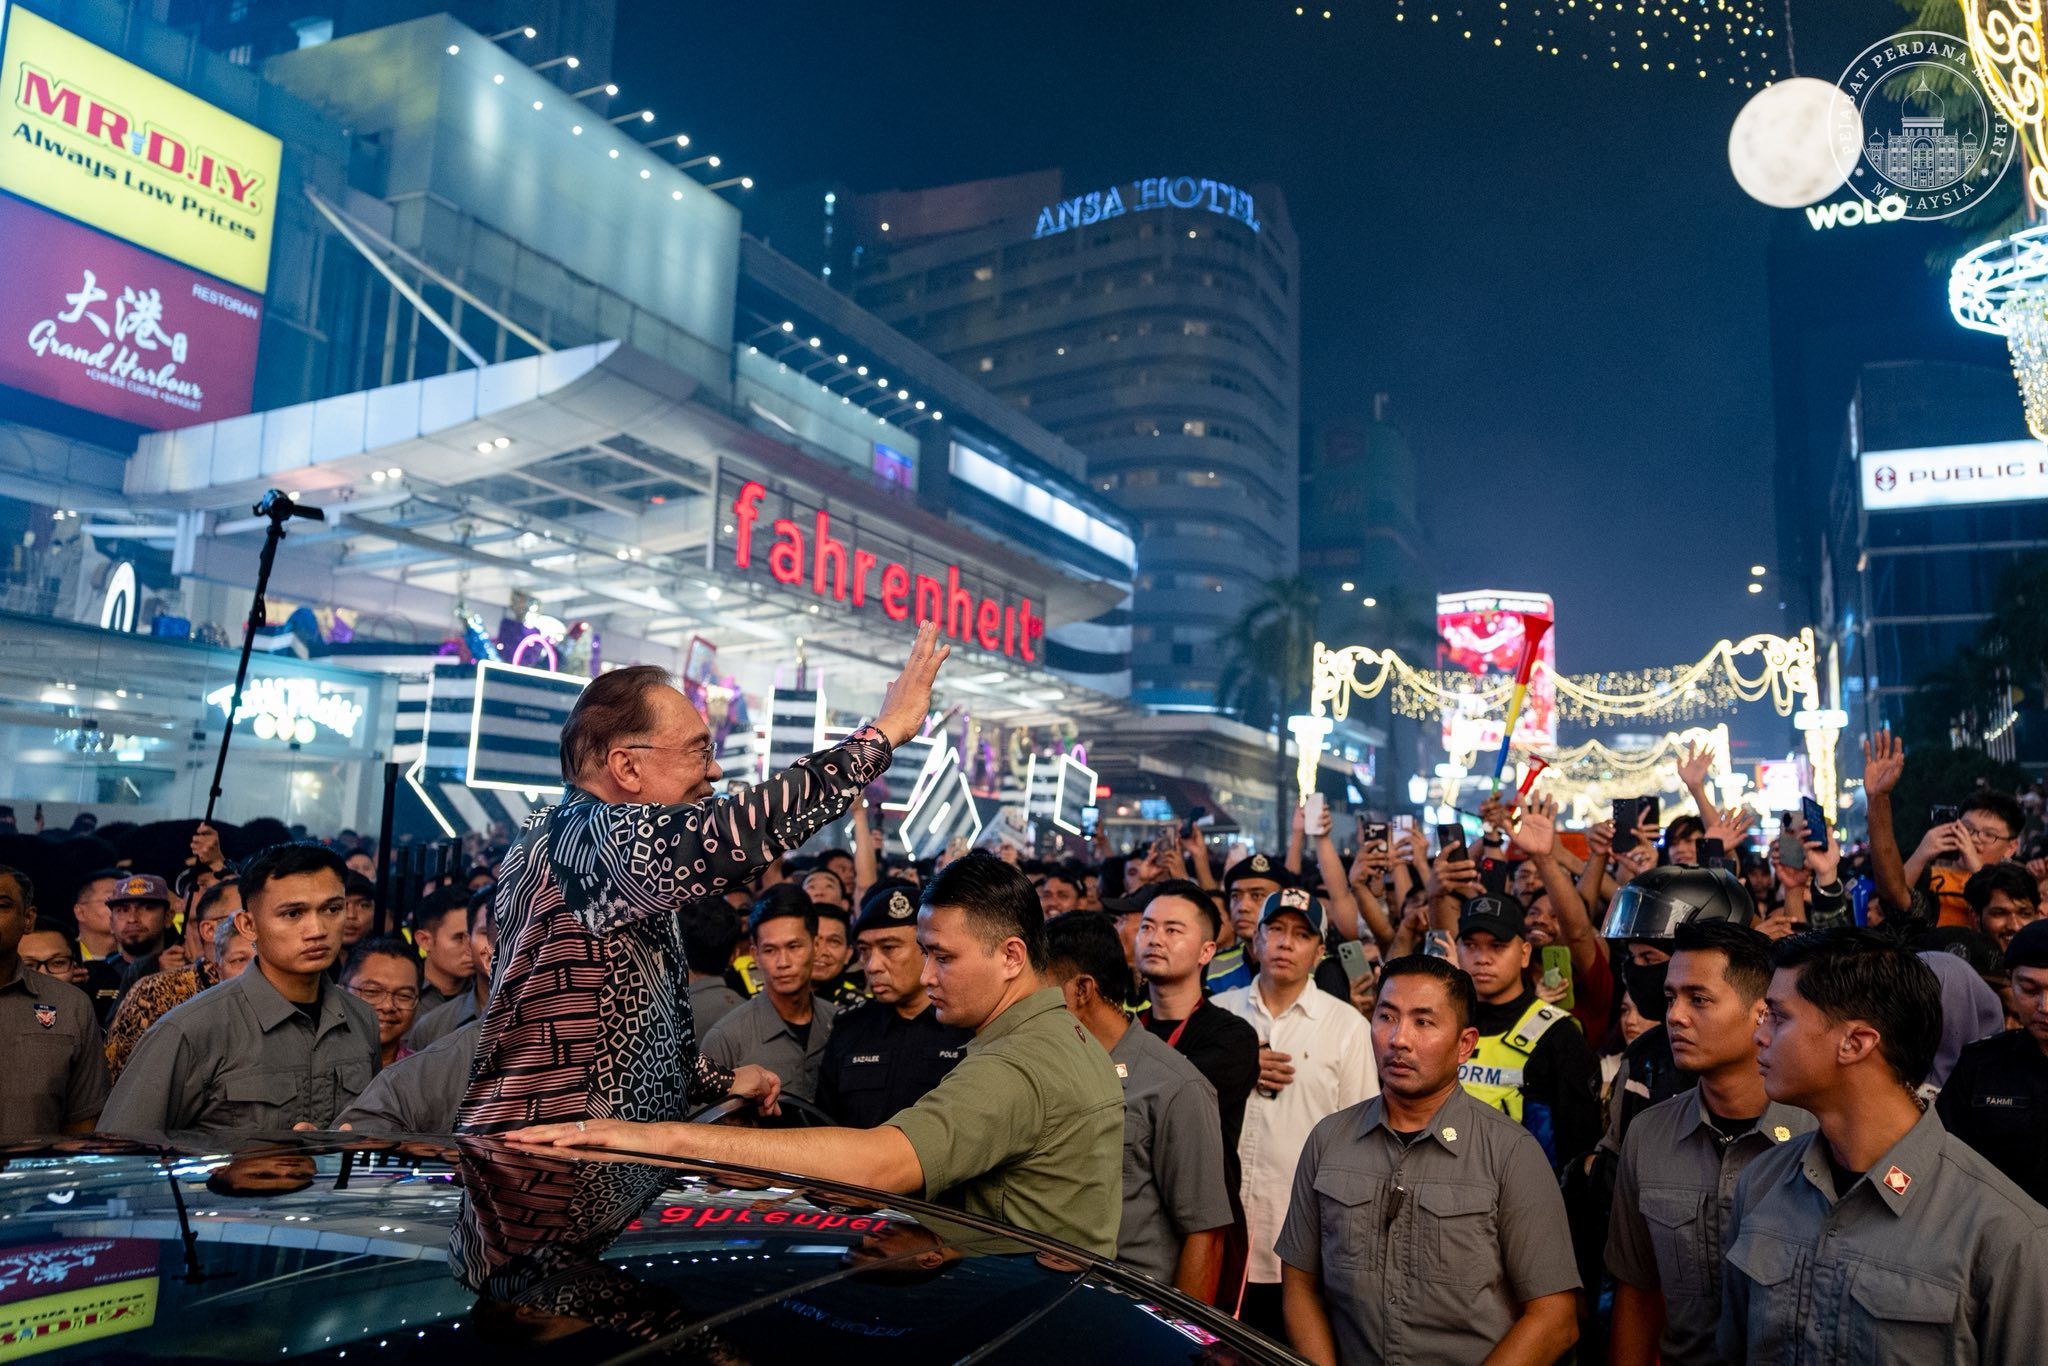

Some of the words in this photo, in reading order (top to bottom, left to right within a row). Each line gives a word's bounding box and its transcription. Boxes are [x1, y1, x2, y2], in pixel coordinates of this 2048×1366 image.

[23, 70, 129, 150] MR
[147, 130, 257, 209] D.I.Y.
[13, 122, 117, 180] Always
[124, 170, 177, 205] Low
[182, 196, 257, 241] Prices
[1031, 185, 1127, 240] ANSA
[1805, 195, 1906, 231] WOLO
[192, 283, 259, 320] RESTORAN
[28, 319, 115, 369] Grand
[109, 345, 203, 400] Harbour
[1909, 462, 2026, 484] PUBLIC
[733, 481, 1036, 663] fahrenheit
[1985, 1096, 2013, 1106] FAHMI
